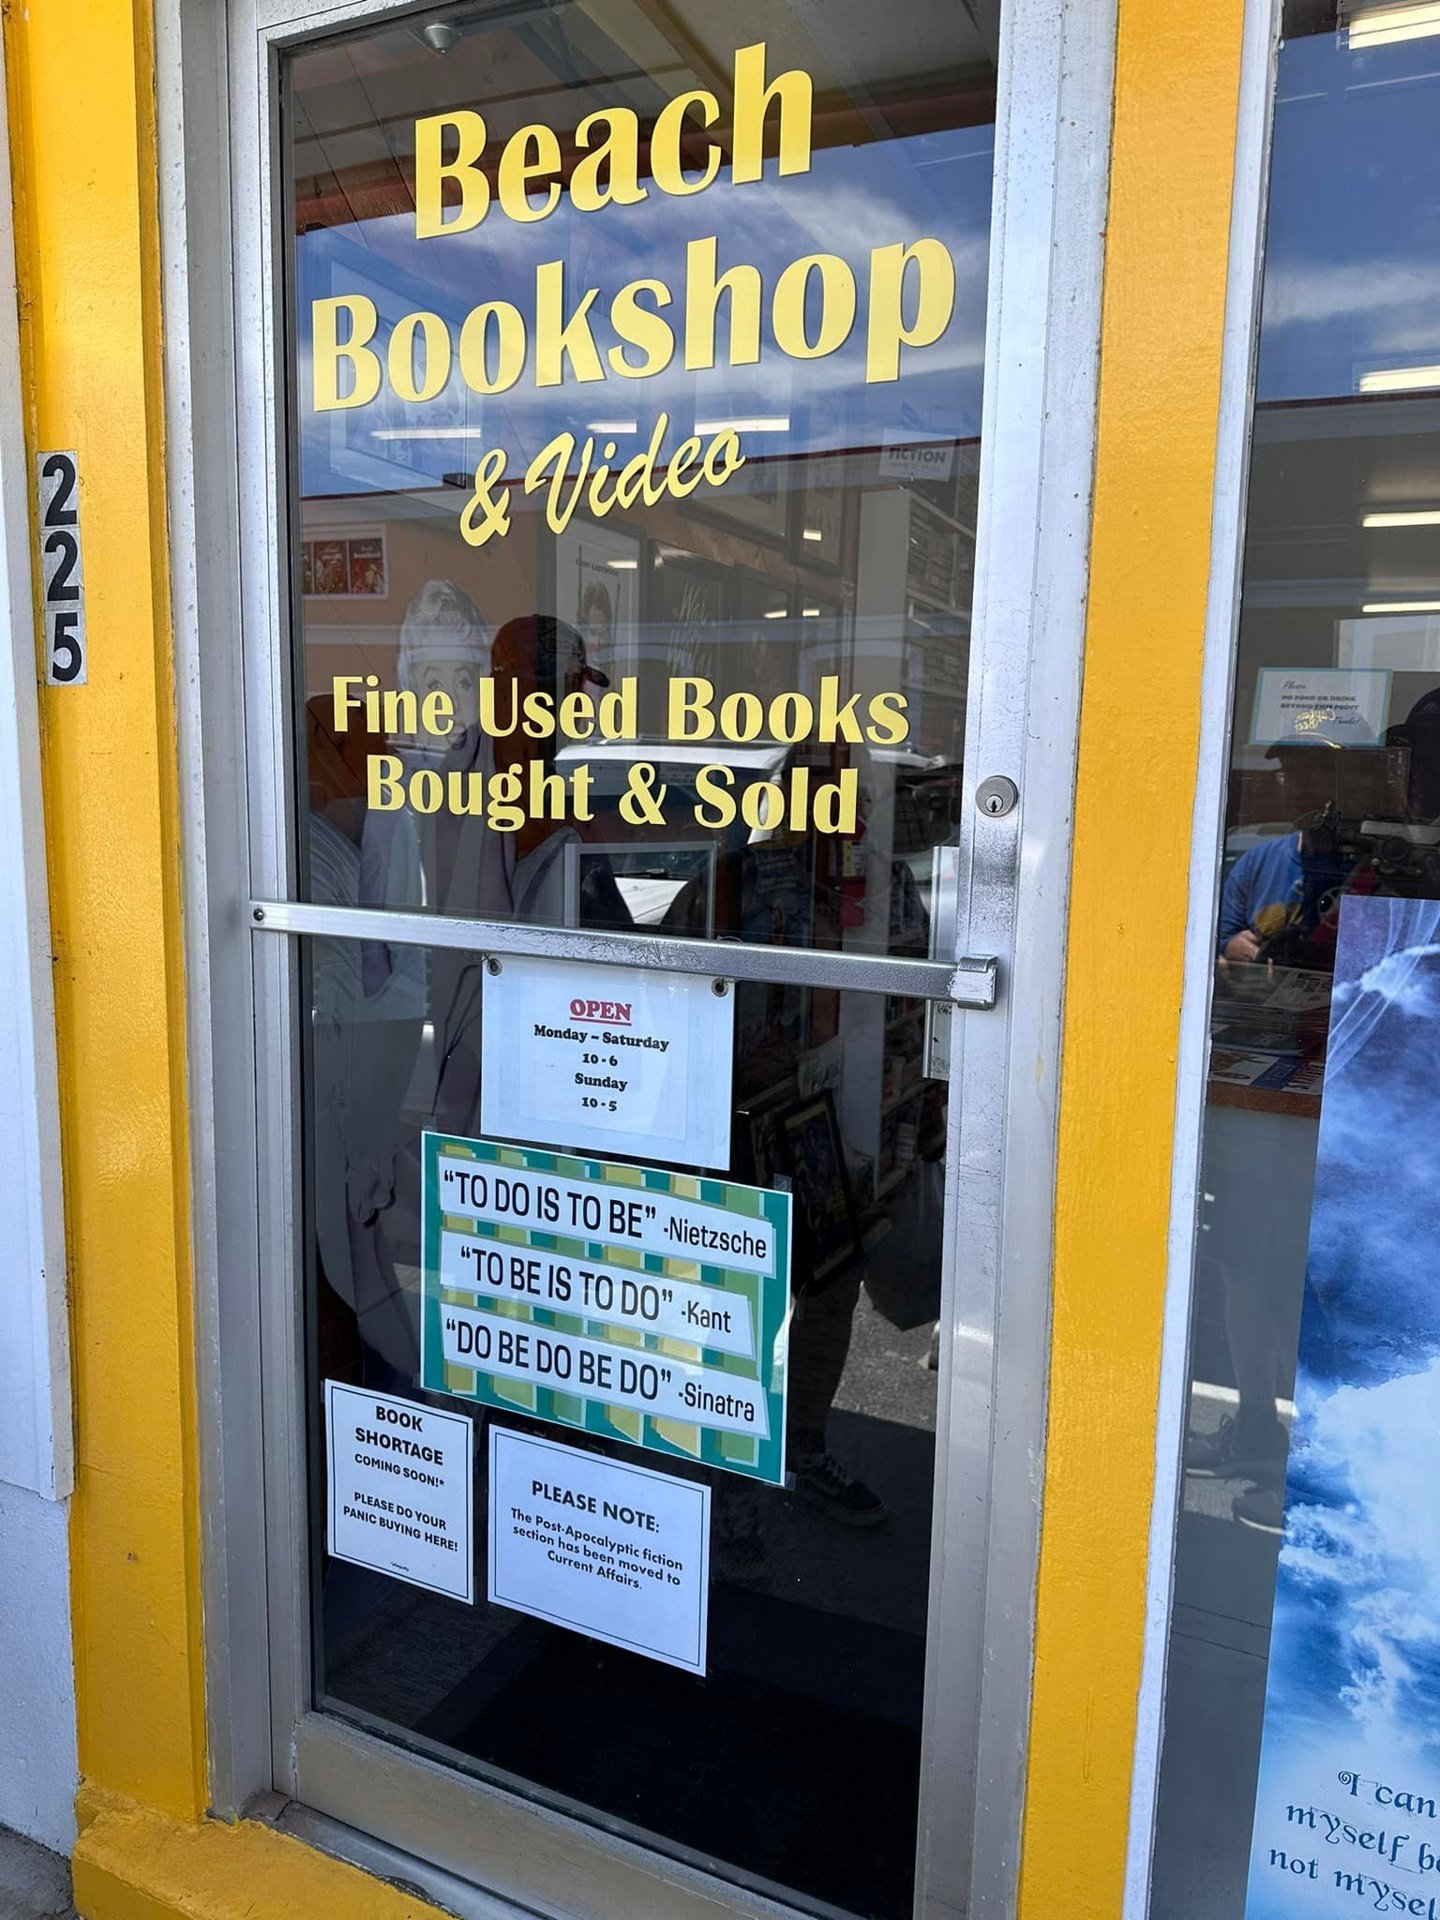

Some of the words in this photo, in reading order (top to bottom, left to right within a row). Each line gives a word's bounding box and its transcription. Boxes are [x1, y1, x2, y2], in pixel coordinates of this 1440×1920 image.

[415, 42, 812, 239] Beach
[312, 236, 955, 412] Bookshop
[459, 448, 511, 547] &
[525, 413, 746, 535] Video
[42, 454, 82, 682] 225
[332, 675, 454, 736] Fine
[479, 676, 637, 739] Used
[667, 675, 909, 744] Books
[366, 754, 594, 831] Bought
[618, 762, 667, 825] &
[694, 764, 858, 834] Sold
[570, 999, 632, 1022] OPEN
[534, 1025, 588, 1044] Monday
[602, 1032, 669, 1052] Saturday
[583, 1053, 598, 1064] 10
[609, 1055, 618, 1066] 6
[574, 1072, 628, 1092] Sunday
[582, 1097, 598, 1108] 10
[608, 1101, 617, 1112] 5
[495, 1178, 531, 1217] DO
[537, 1185, 560, 1222] IS
[567, 1191, 601, 1230] TO
[663, 1219, 767, 1258] -Nietzsche
[510, 1258, 541, 1295] BE
[548, 1265, 572, 1301] IS
[579, 1271, 613, 1311] TO
[681, 1302, 731, 1333] -Kant
[499, 1330, 529, 1368] BE
[536, 1340, 572, 1379] DO
[579, 1350, 612, 1389] BE
[678, 1384, 755, 1422] -Sinatra
[376, 1405, 423, 1432] BOOK
[355, 1427, 443, 1466] SHORTAGE
[355, 1453, 401, 1475] COMING
[343, 1505, 377, 1524] PANIC
[379, 1517, 421, 1539] BUYING
[424, 1532, 458, 1552] HERE!
[354, 1492, 394, 1512] PLEASE
[397, 1505, 413, 1518] DO
[415, 1511, 446, 1530] YOUR
[532, 1480, 597, 1514] PLEASE
[603, 1501, 660, 1533] NOTE:
[511, 1507, 532, 1524] The
[536, 1515, 639, 1558] Post-Apocalyptic
[643, 1548, 683, 1571] fiction
[513, 1526, 554, 1545] section
[558, 1538, 580, 1554] has
[584, 1545, 615, 1565] been
[619, 1560, 663, 1580] moved
[667, 1574, 681, 1586] to
[547, 1550, 593, 1573] Current
[597, 1566, 642, 1589] Affairs.
[1375, 1785, 1437, 1818] can
[1286, 1805, 1410, 1862] myself
[1270, 1849, 1318, 1879] not
